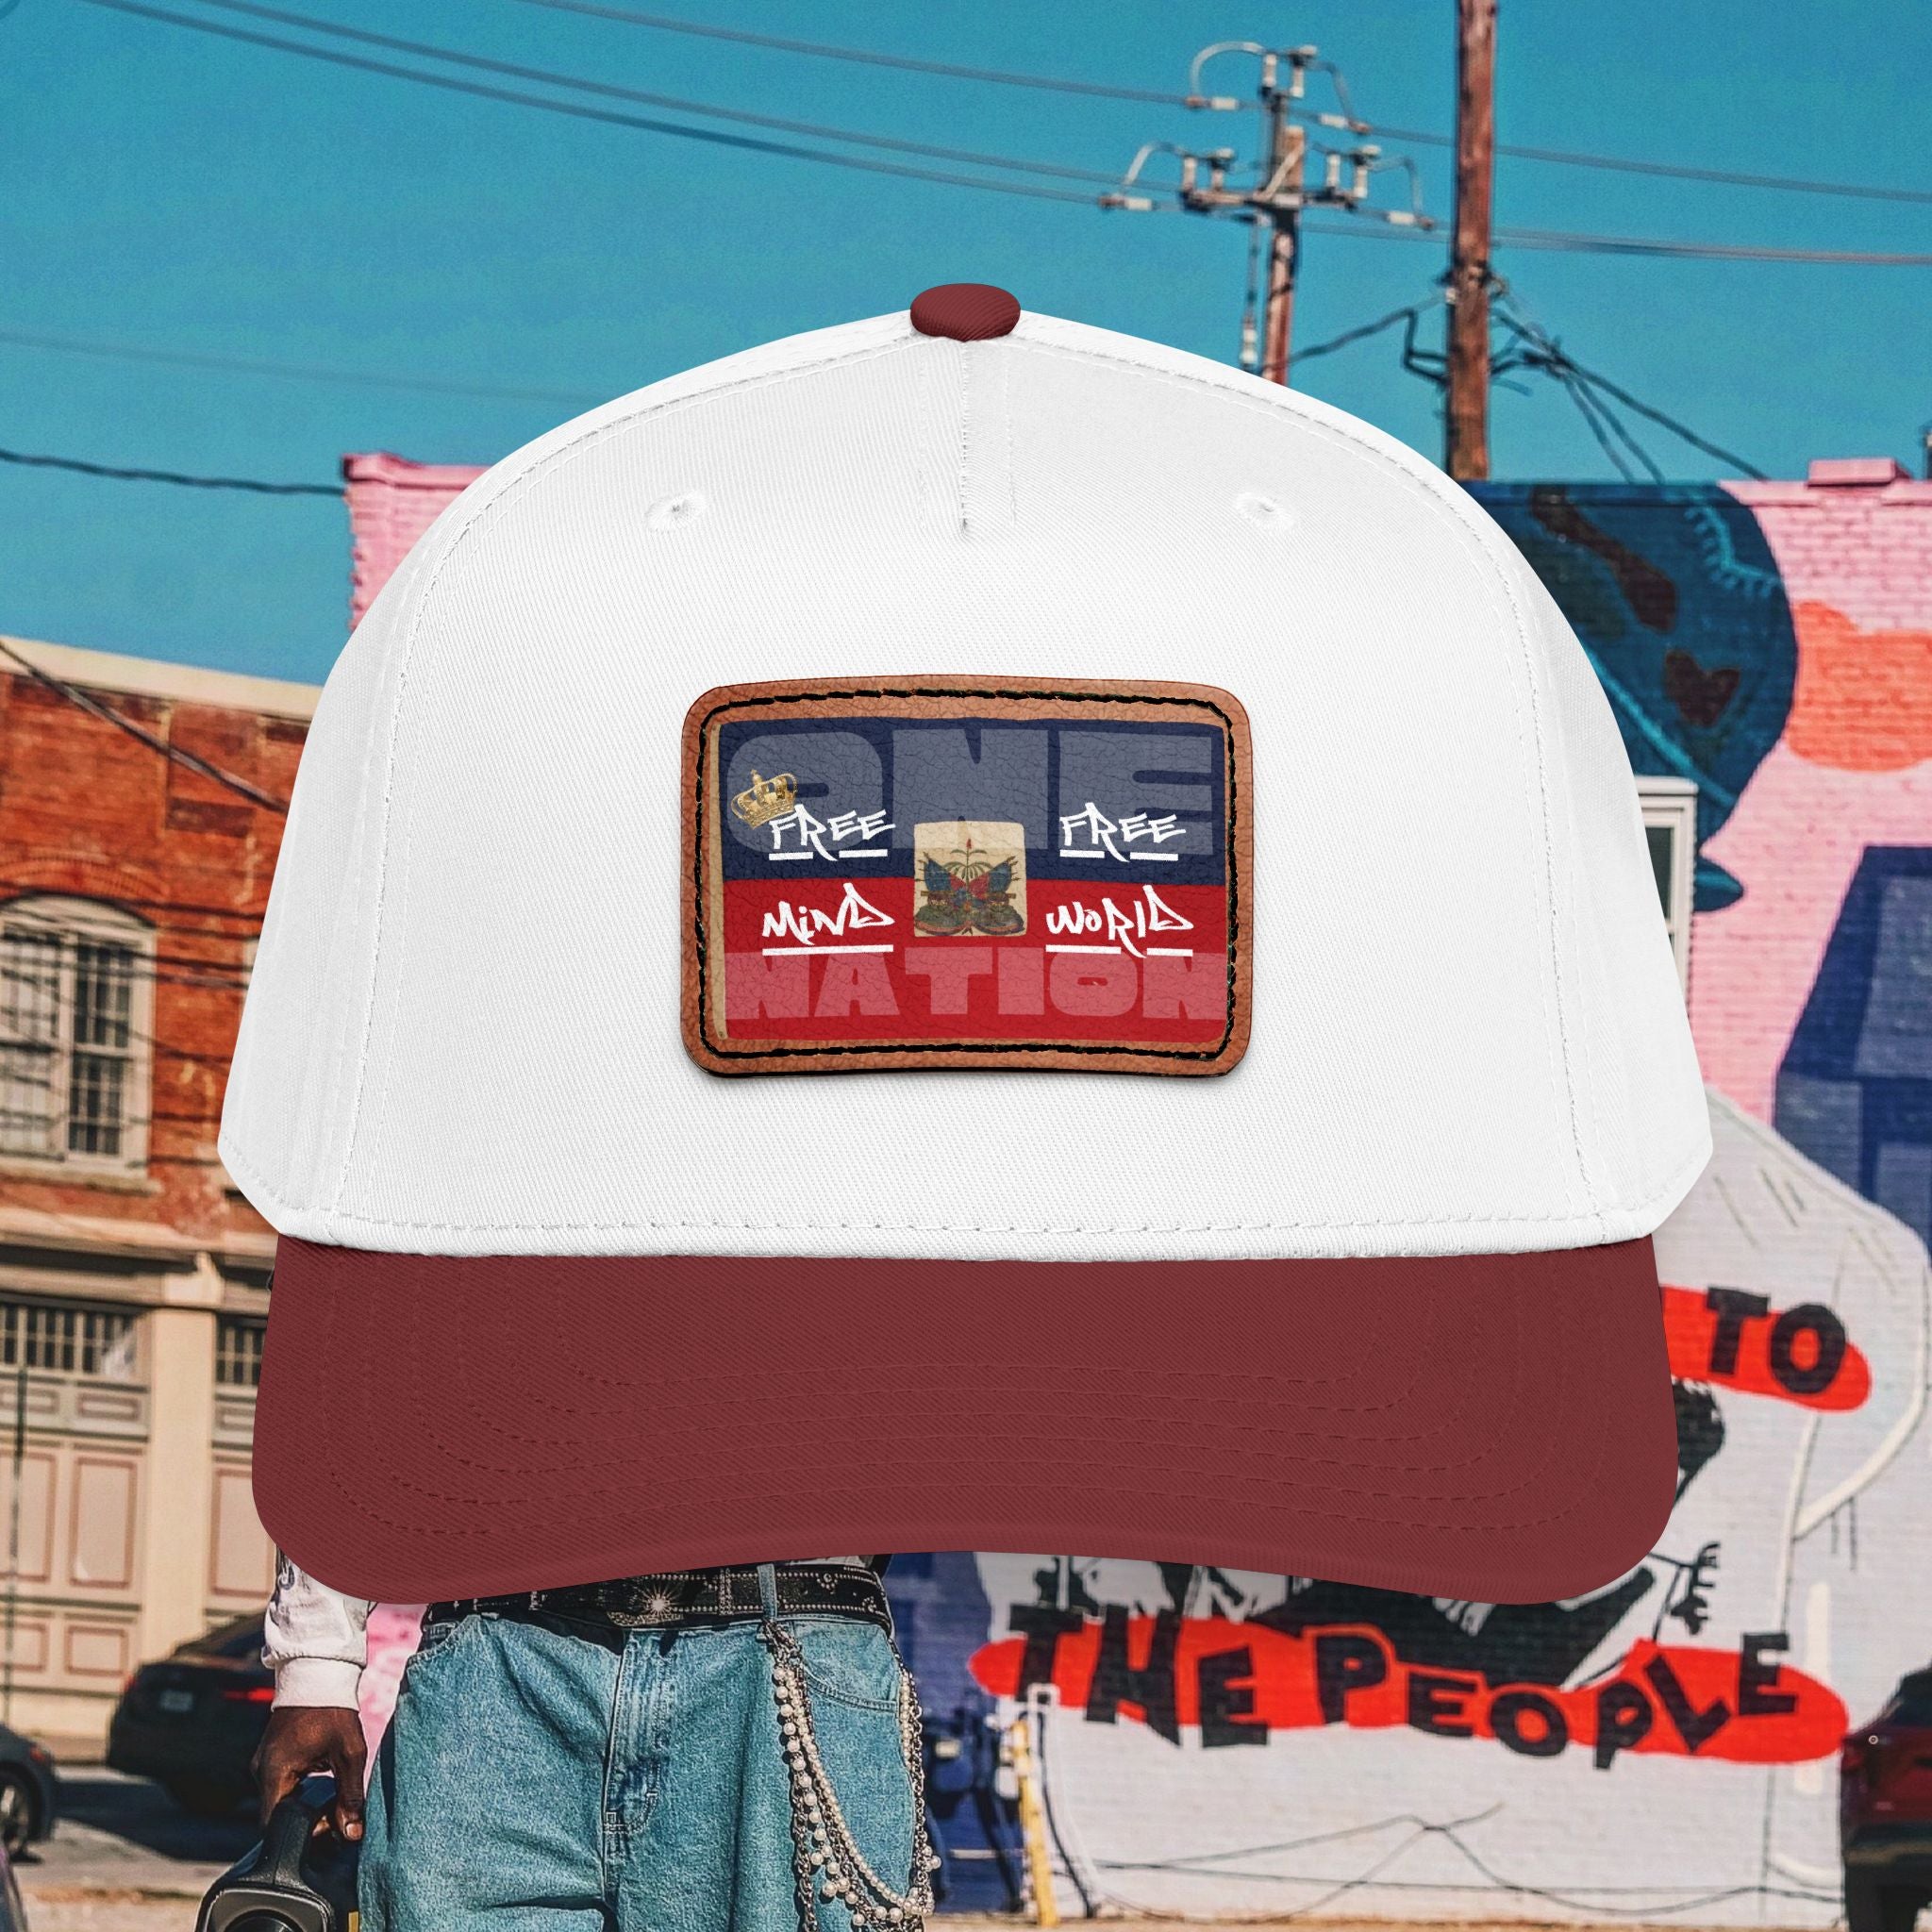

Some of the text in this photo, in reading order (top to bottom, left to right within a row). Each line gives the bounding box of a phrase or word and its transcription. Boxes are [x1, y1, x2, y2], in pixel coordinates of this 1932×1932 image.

[726, 728, 1213, 856] ONE
[768, 803, 896, 861] FREE
[1059, 802, 1186, 862] FREE
[724, 946, 1226, 1020] NATION
[1708, 1287, 1846, 1393] TO
[1008, 1605, 1797, 1770] THE PEOPLE
